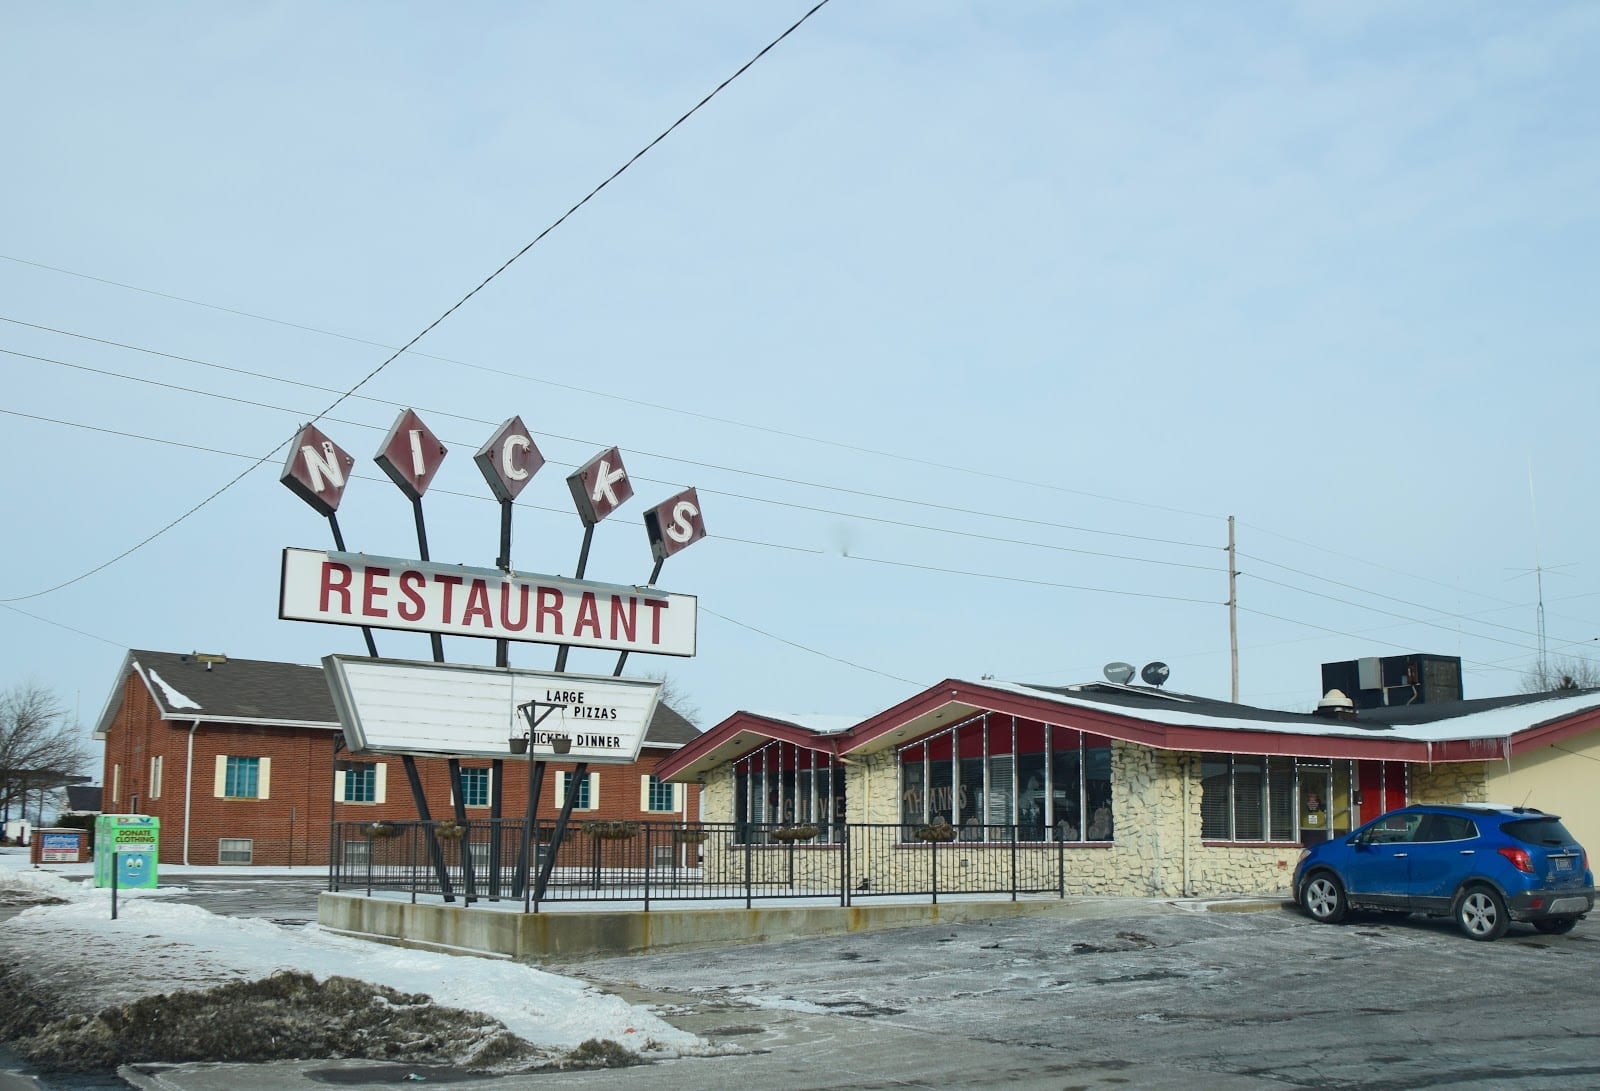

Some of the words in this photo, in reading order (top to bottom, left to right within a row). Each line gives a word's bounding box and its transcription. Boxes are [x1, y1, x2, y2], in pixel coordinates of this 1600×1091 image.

[302, 429, 699, 544] NICKS
[318, 560, 670, 645] RESTAURANT
[546, 690, 585, 704] LARGE
[574, 706, 617, 720] PIZZAS
[576, 734, 620, 748] DINNER
